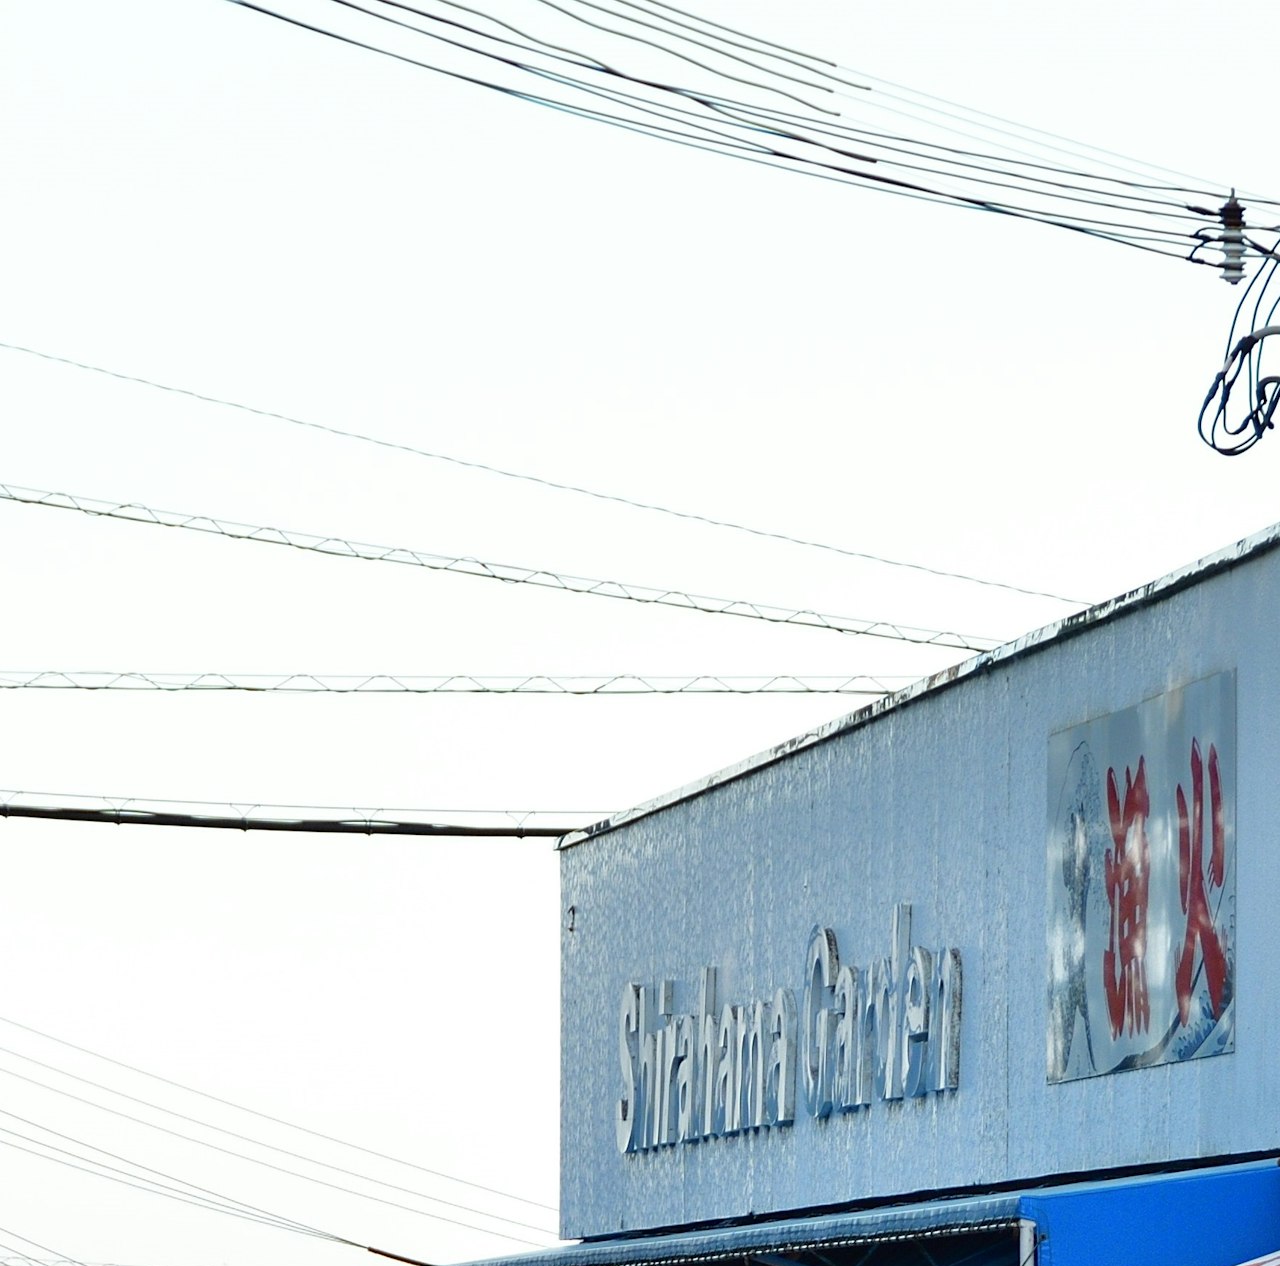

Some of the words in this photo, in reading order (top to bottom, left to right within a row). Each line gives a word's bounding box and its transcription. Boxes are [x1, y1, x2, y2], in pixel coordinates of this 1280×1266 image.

[1103, 736, 1231, 1040] 漁火
[616, 966, 797, 1154] Shirahama
[802, 903, 963, 1120] Garden
